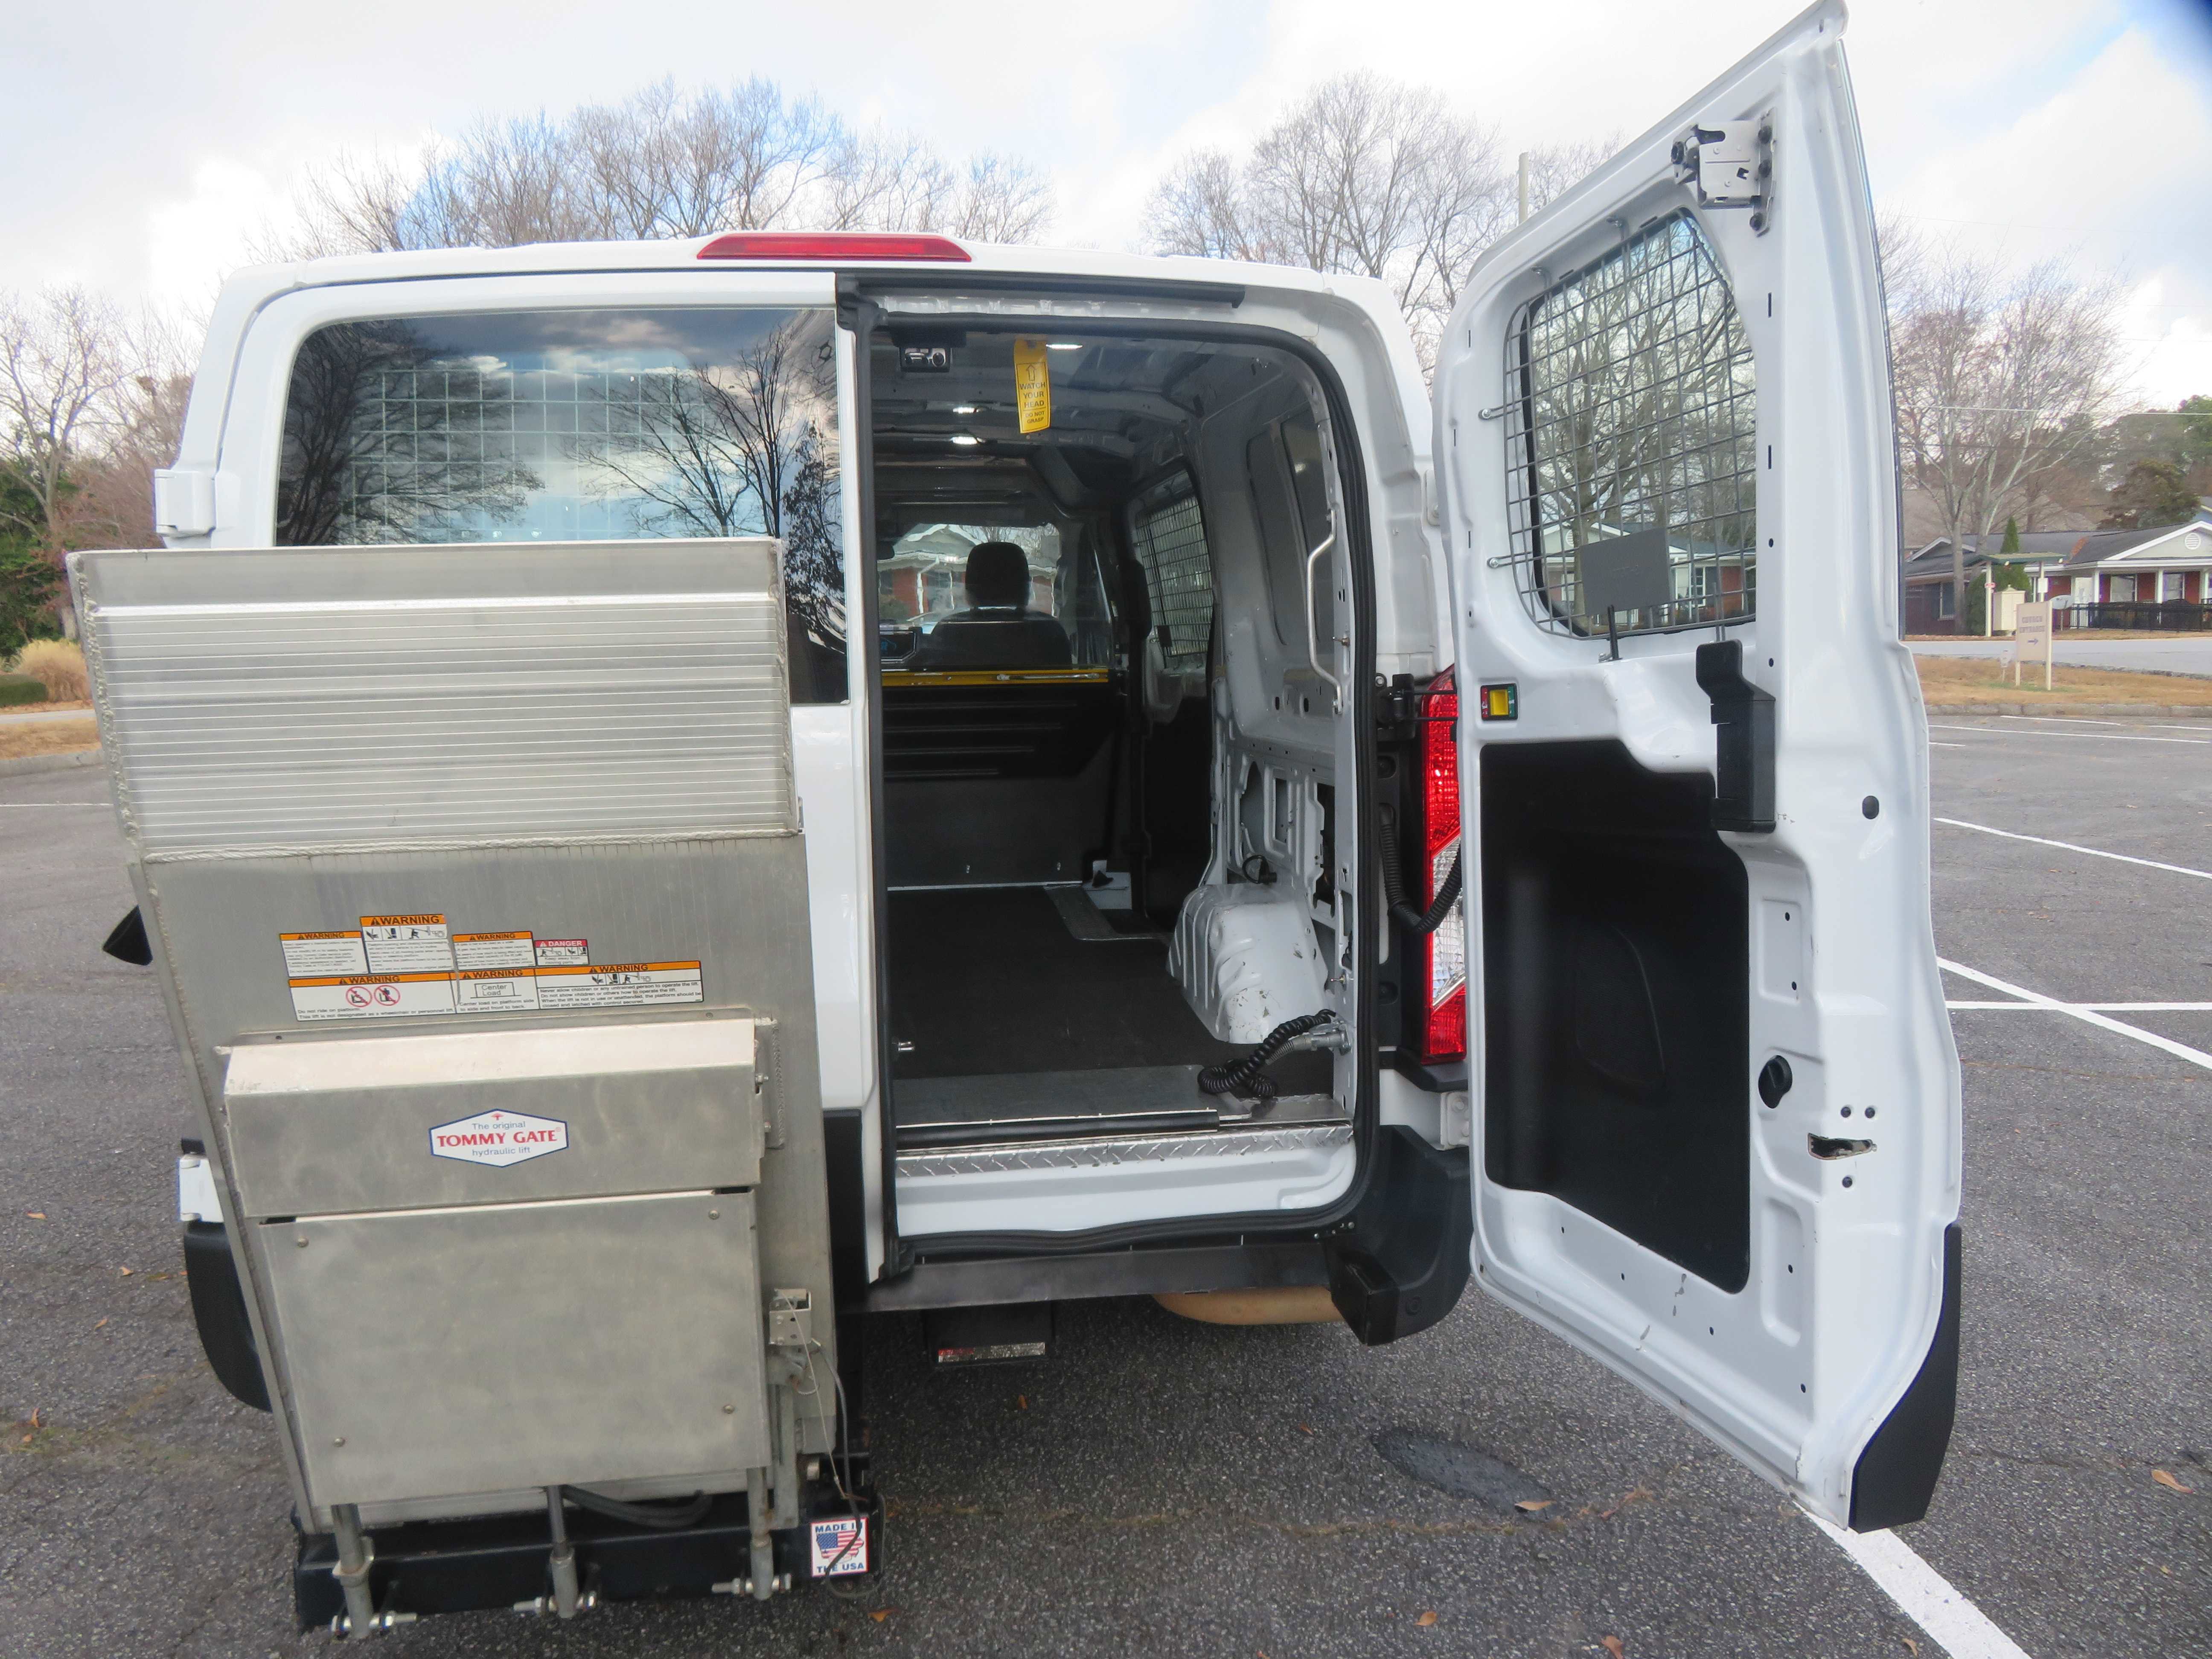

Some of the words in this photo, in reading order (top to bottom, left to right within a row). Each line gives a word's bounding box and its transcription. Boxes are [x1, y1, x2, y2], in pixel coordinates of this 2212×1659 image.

[1023, 391, 1044, 399] YOUR
[381, 916, 439, 925] WARNING
[493, 1121, 526, 1130] original
[437, 1132, 506, 1147] TOMMY
[472, 1147, 515, 1156] hydraulic
[815, 1523, 847, 1533] MADE
